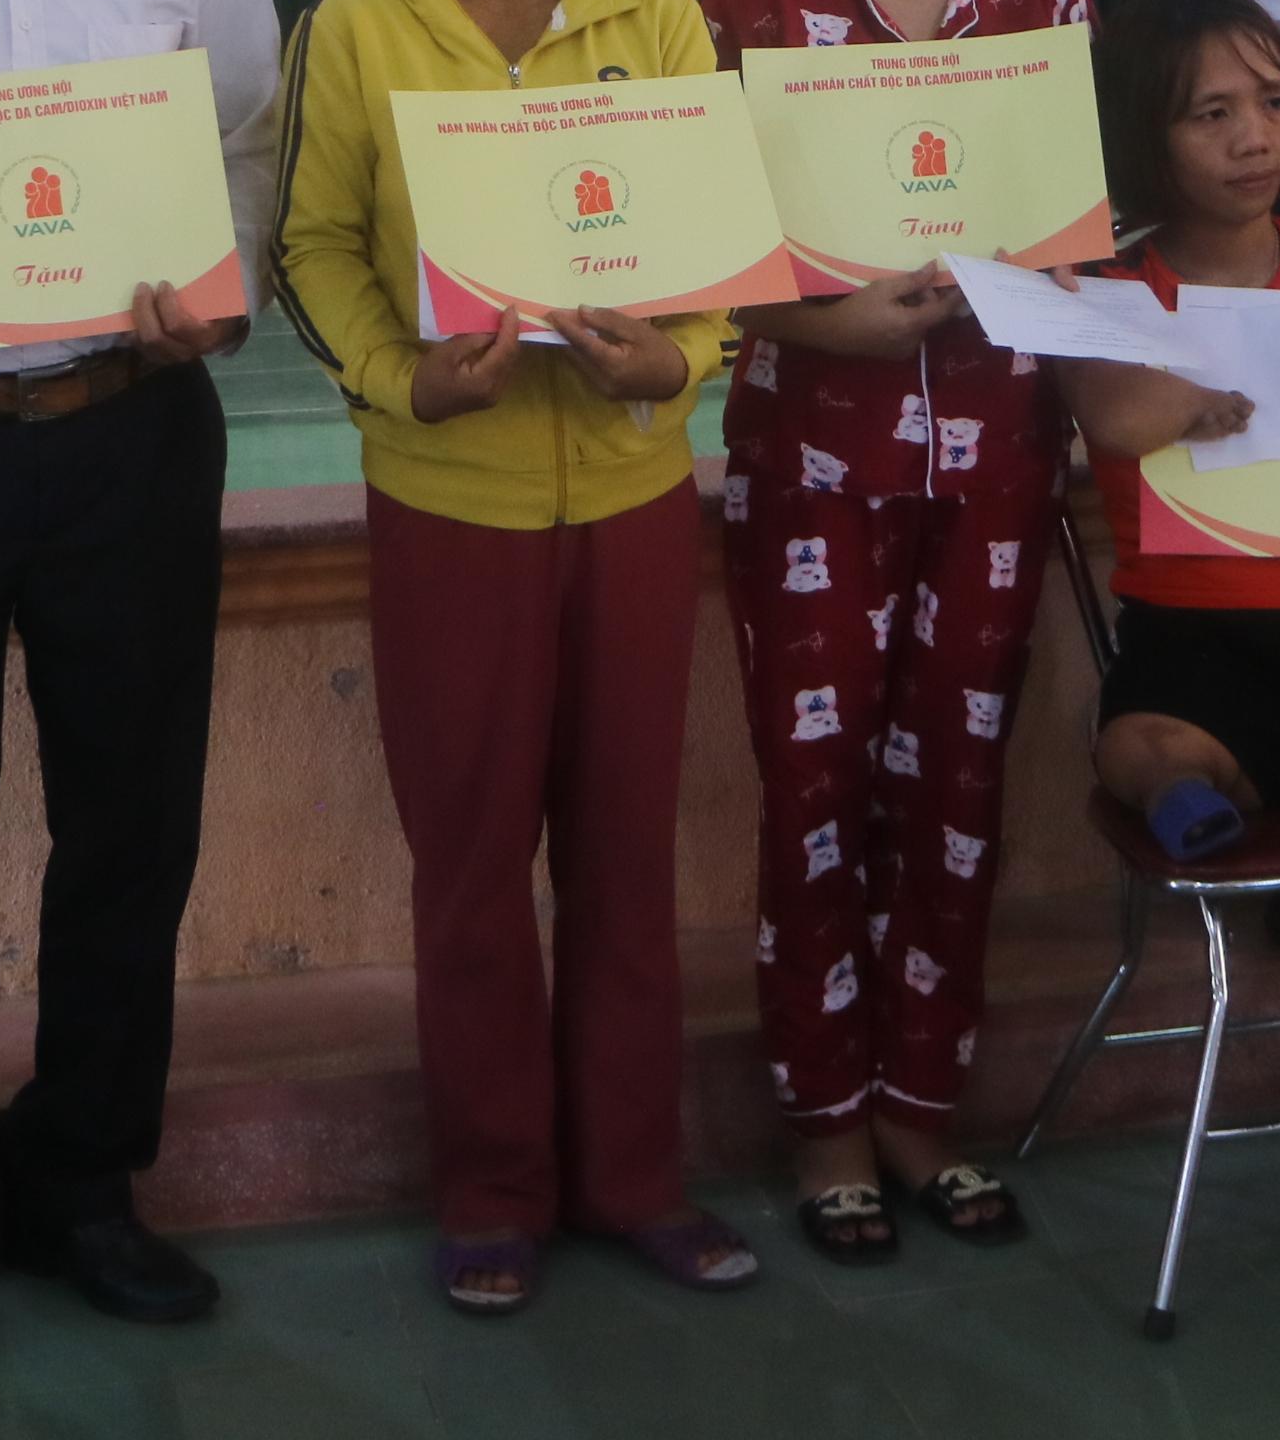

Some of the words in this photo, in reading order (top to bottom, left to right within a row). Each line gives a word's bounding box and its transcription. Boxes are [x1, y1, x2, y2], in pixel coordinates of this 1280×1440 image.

[871, 58, 906, 70] TRUNG
[908, 55, 939, 68] ƯƠNG
[941, 53, 960, 67] HỘI
[784, 81, 809, 93] NẠN
[812, 77, 845, 92] NHÂN
[848, 73, 876, 89] CHẤT
[879, 74, 903, 88] ĐỘC
[905, 75, 921, 87] DA
[995, 65, 1018, 79] VIỆT
[1022, 60, 1049, 75] NAM
[16, 84, 49, 99] ƯƠNG
[52, 79, 72, 96] HỘI
[14, 106, 32, 119] DA
[110, 93, 135, 108] VIỆT
[138, 90, 168, 105] NAM
[520, 101, 558, 114] TRUNG
[560, 98, 592, 112] ƯƠNG
[594, 94, 614, 108] HỘI
[437, 122, 463, 134] NẠN
[465, 122, 498, 133] NHÂN
[500, 118, 529, 134] CHẤT
[532, 118, 557, 133] ĐỘC
[559, 117, 576, 129] DA
[650, 108, 674, 120] VIỆT
[677, 106, 705, 118] NAM
[901, 179, 957, 193] VAVA
[13, 217, 74, 238] VAVA
[566, 212, 626, 232] VAVA
[899, 218, 963, 239] Tặng
[569, 256, 637, 275] Tặng
[13, 265, 83, 287] Tặng
